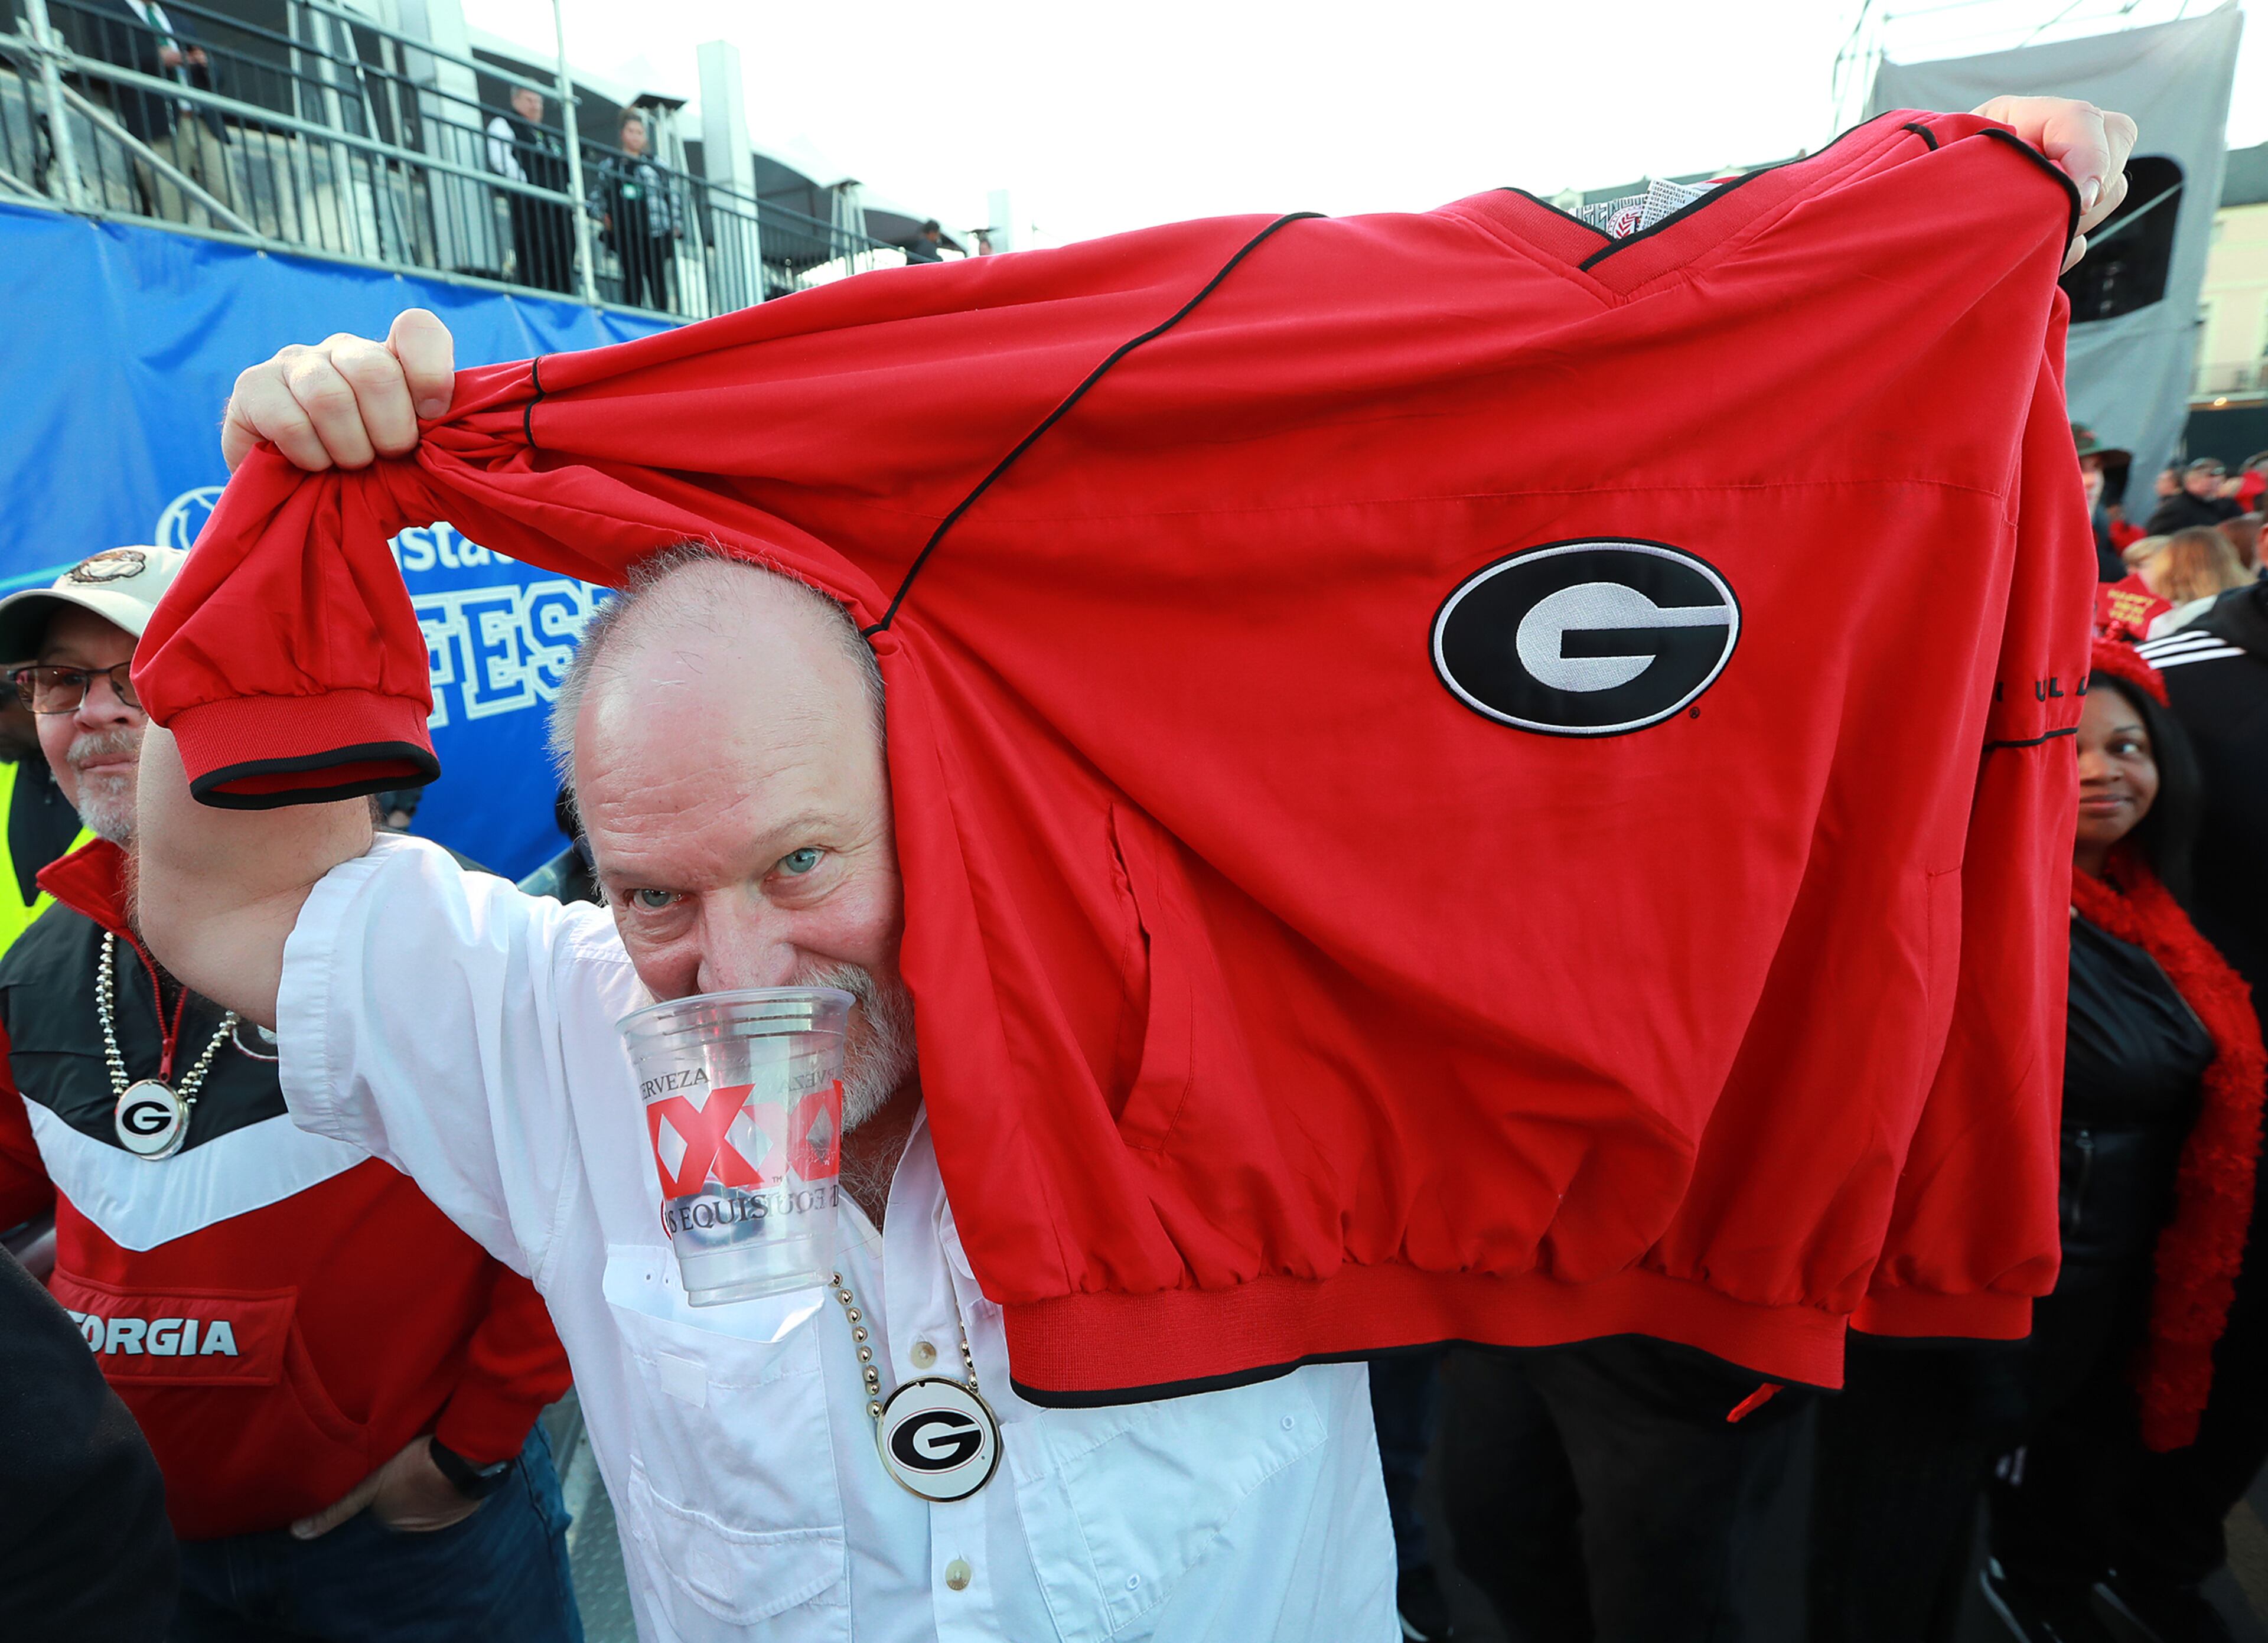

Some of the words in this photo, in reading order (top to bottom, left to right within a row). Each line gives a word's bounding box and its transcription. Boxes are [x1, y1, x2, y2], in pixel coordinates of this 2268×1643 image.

[409, 579, 619, 731] FES
[1432, 540, 1740, 735] G
[640, 1068, 711, 1100] ERVEZA
[122, 1101, 172, 1135] G
[679, 1194, 769, 1231] EQUIS
[64, 1308, 239, 1356] ORGIA
[891, 1410, 982, 1471] G
